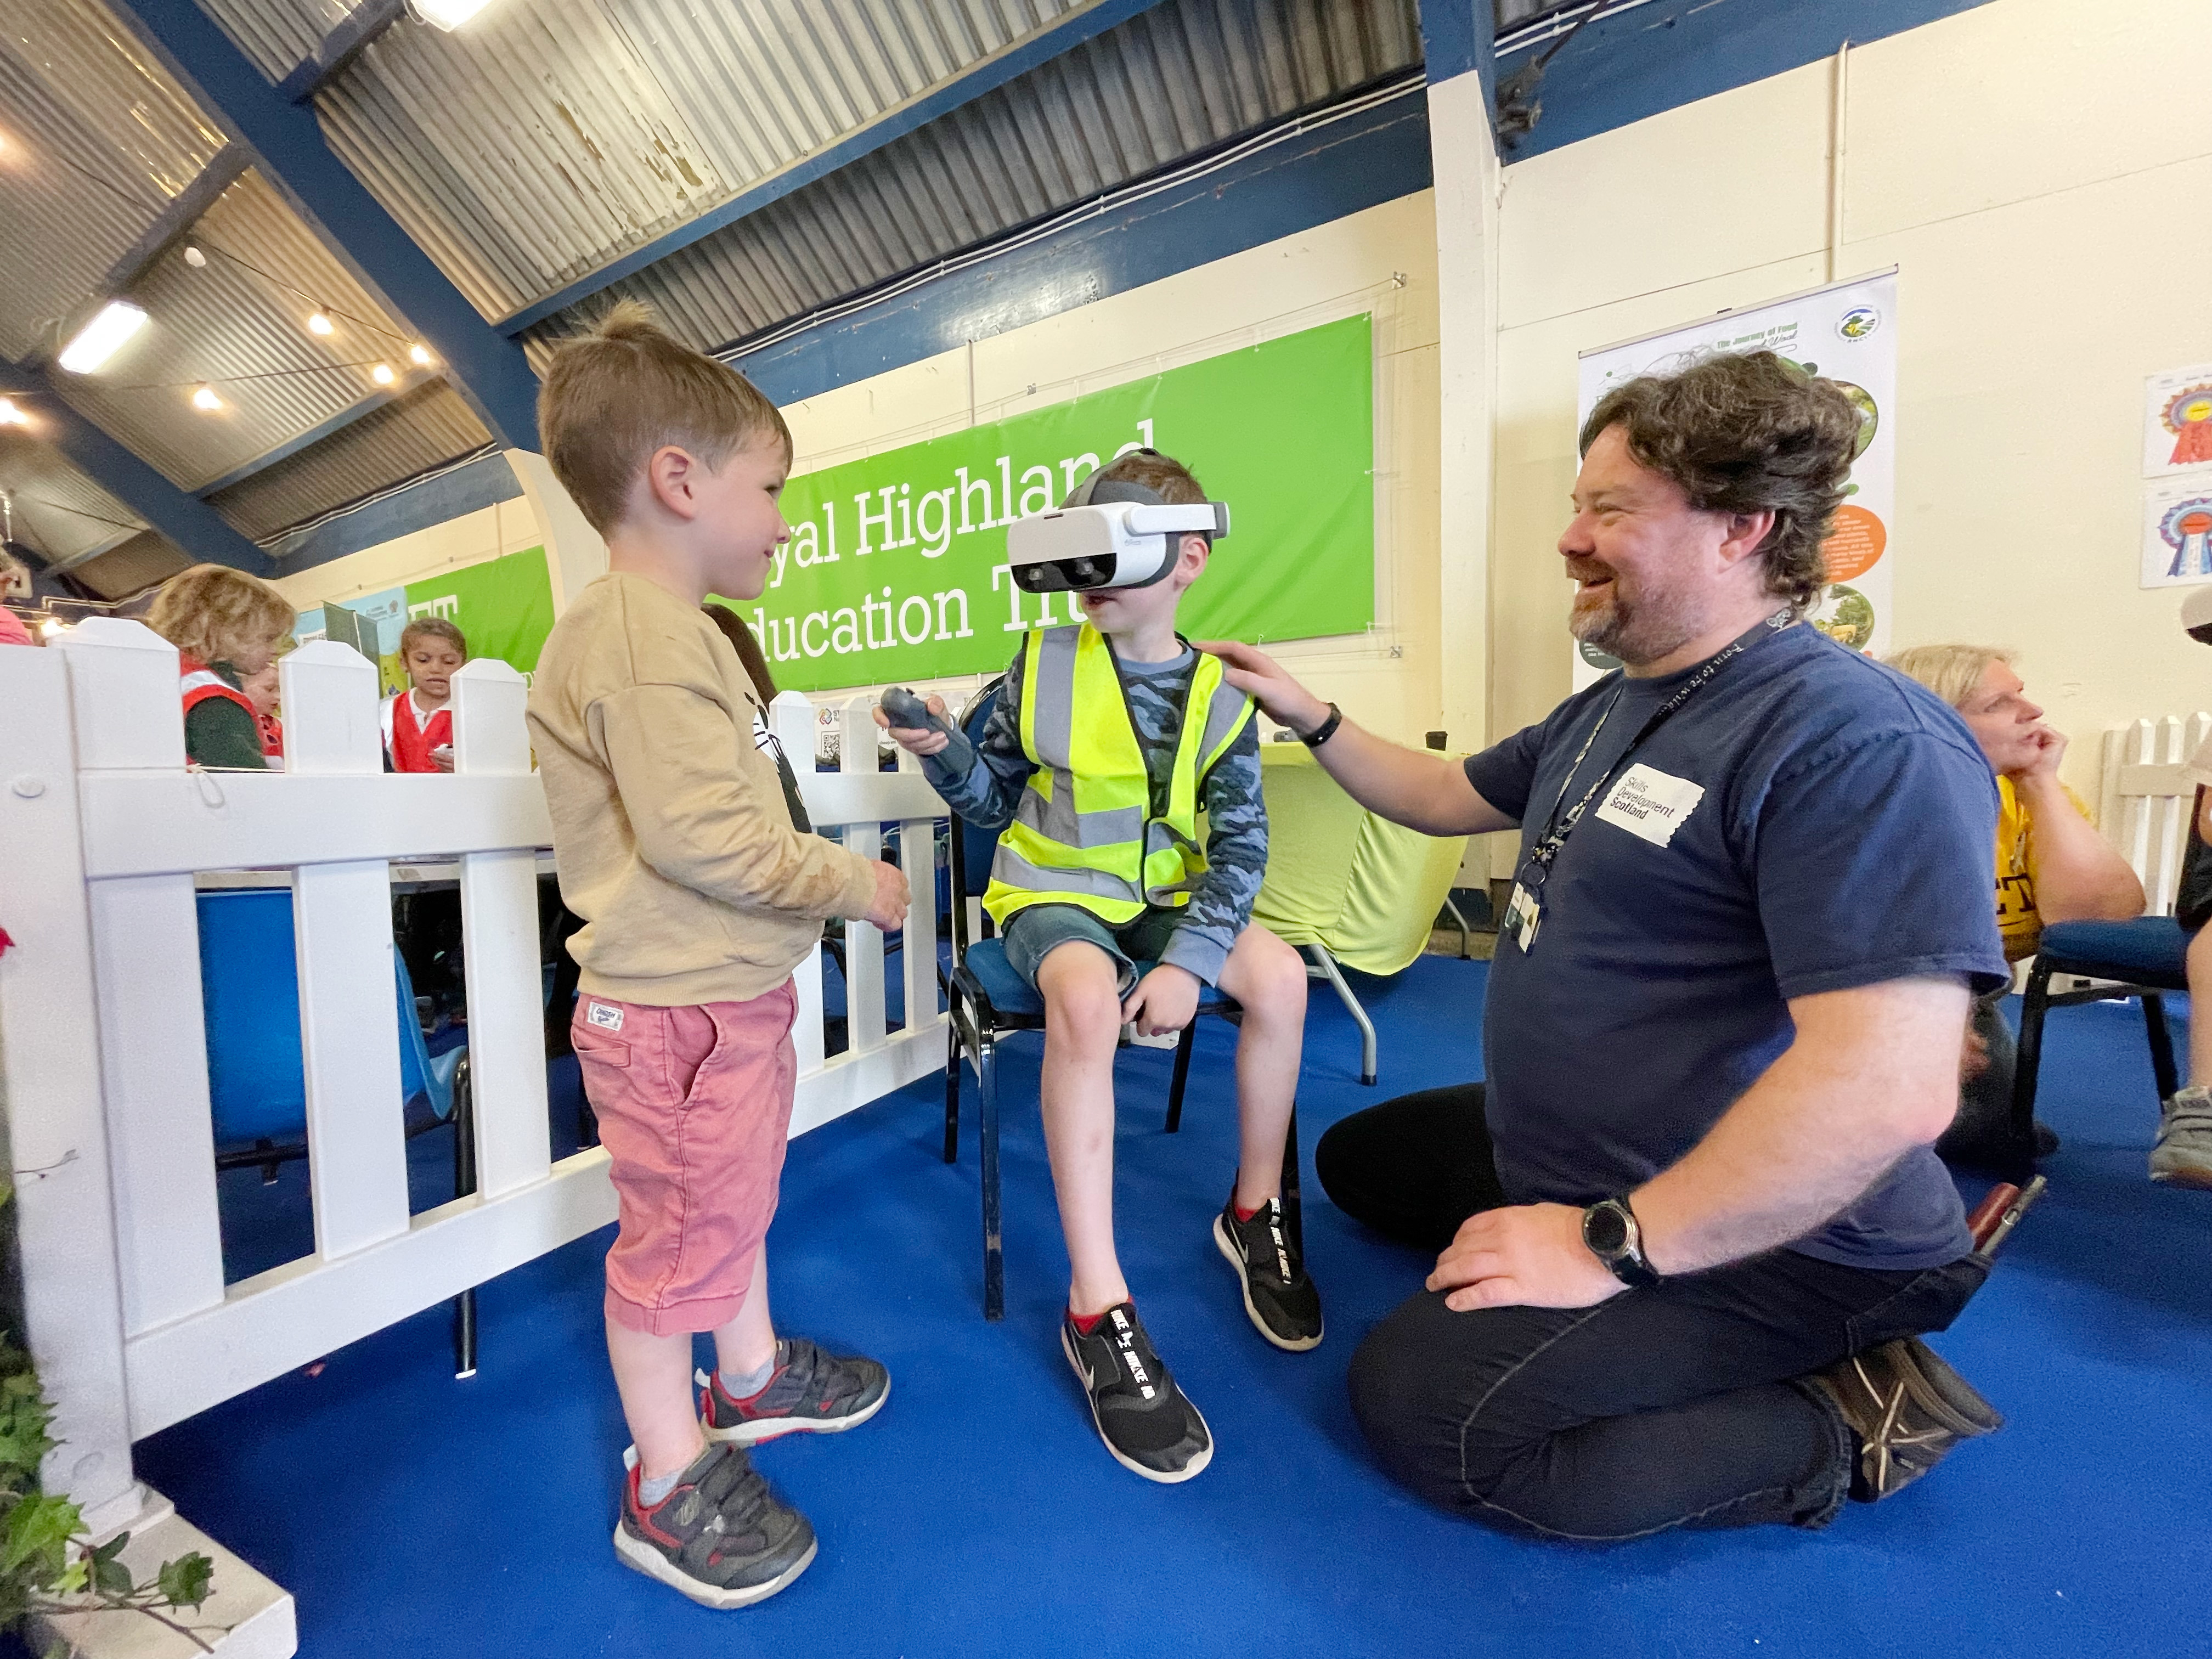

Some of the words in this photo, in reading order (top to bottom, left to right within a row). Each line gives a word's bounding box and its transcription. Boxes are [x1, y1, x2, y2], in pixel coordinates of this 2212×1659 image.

[770, 501, 840, 588] yal
[746, 586, 974, 663] ducation
[1702, 665, 1715, 678] to
[1624, 777, 1649, 793] Skills
[1610, 797, 1649, 820] Scotland
[1617, 786, 1675, 818] Development
[1110, 1309, 1130, 1330] NIKE
